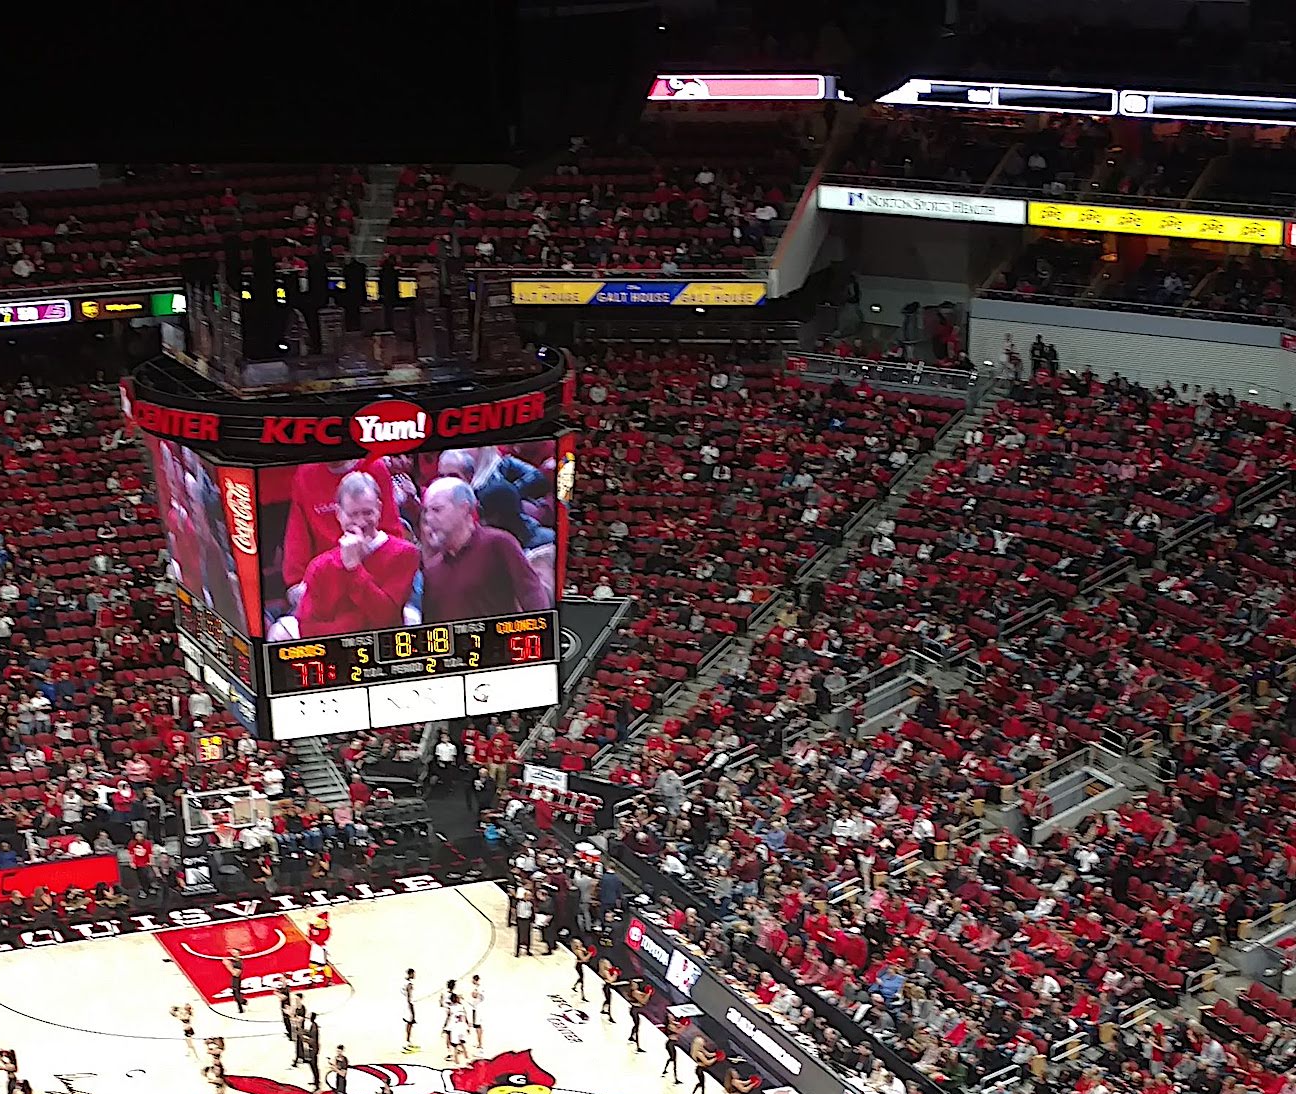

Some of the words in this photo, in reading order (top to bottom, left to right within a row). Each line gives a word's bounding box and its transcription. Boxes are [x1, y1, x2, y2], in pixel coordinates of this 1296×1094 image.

[631, 292, 670, 303] HOUSE
[260, 415, 344, 445] KFC
[354, 411, 426, 443] Yum!
[438, 391, 546, 438] CENTER
[395, 627, 450, 657] 8:18
[292, 660, 325, 687] 77
[510, 634, 542, 662] 50
[351, 666, 362, 681] 2
[426, 657, 437, 673] 2
